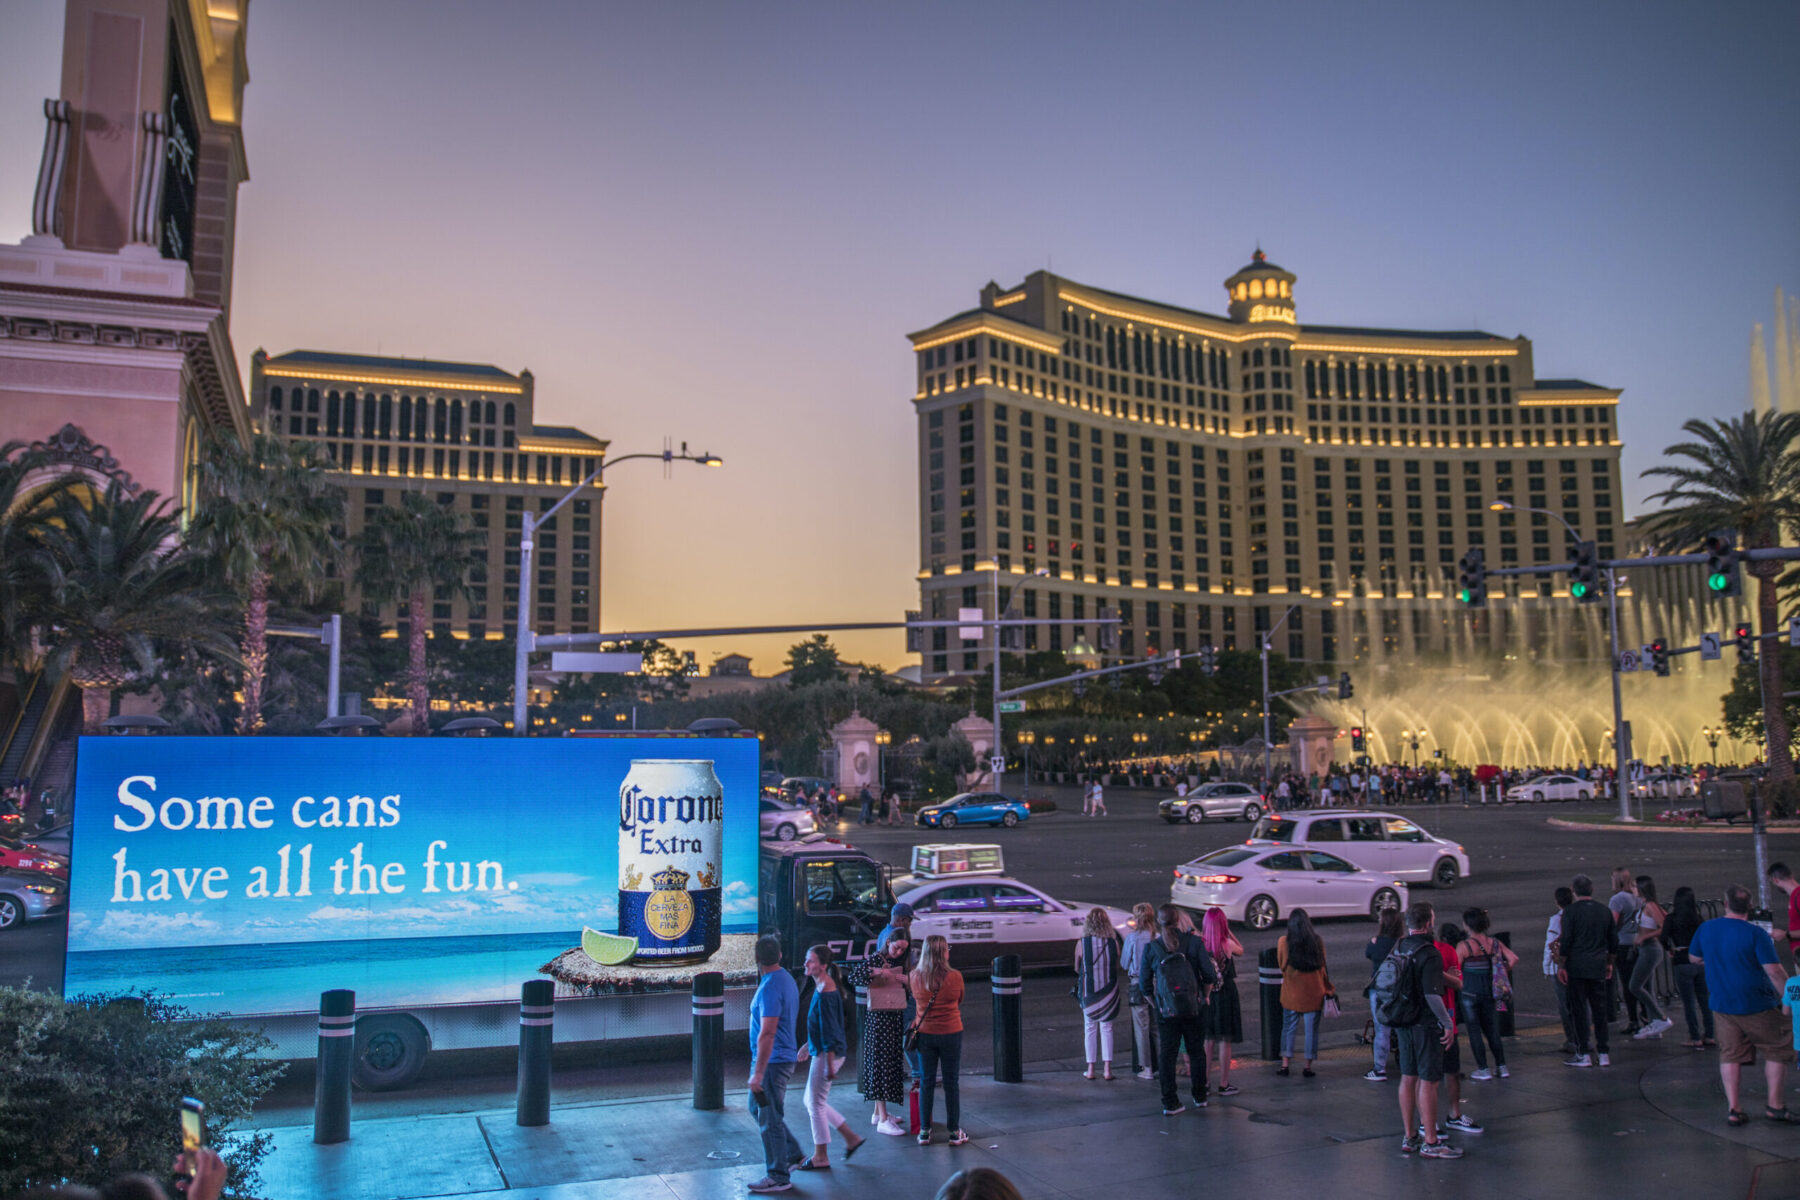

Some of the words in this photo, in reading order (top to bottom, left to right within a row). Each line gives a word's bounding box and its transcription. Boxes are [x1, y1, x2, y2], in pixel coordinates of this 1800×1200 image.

[114, 775, 275, 832] Some
[292, 794, 401, 828] cans
[640, 829, 702, 855] Extra
[110, 847, 229, 902] have
[246, 843, 313, 898] all
[329, 842, 406, 895] the
[422, 840, 519, 893] fun.
[664, 895, 676, 903] LA
[650, 903, 689, 912] CERVEZA
[660, 912, 679, 921] MAS
[659, 921, 679, 930] FINA
